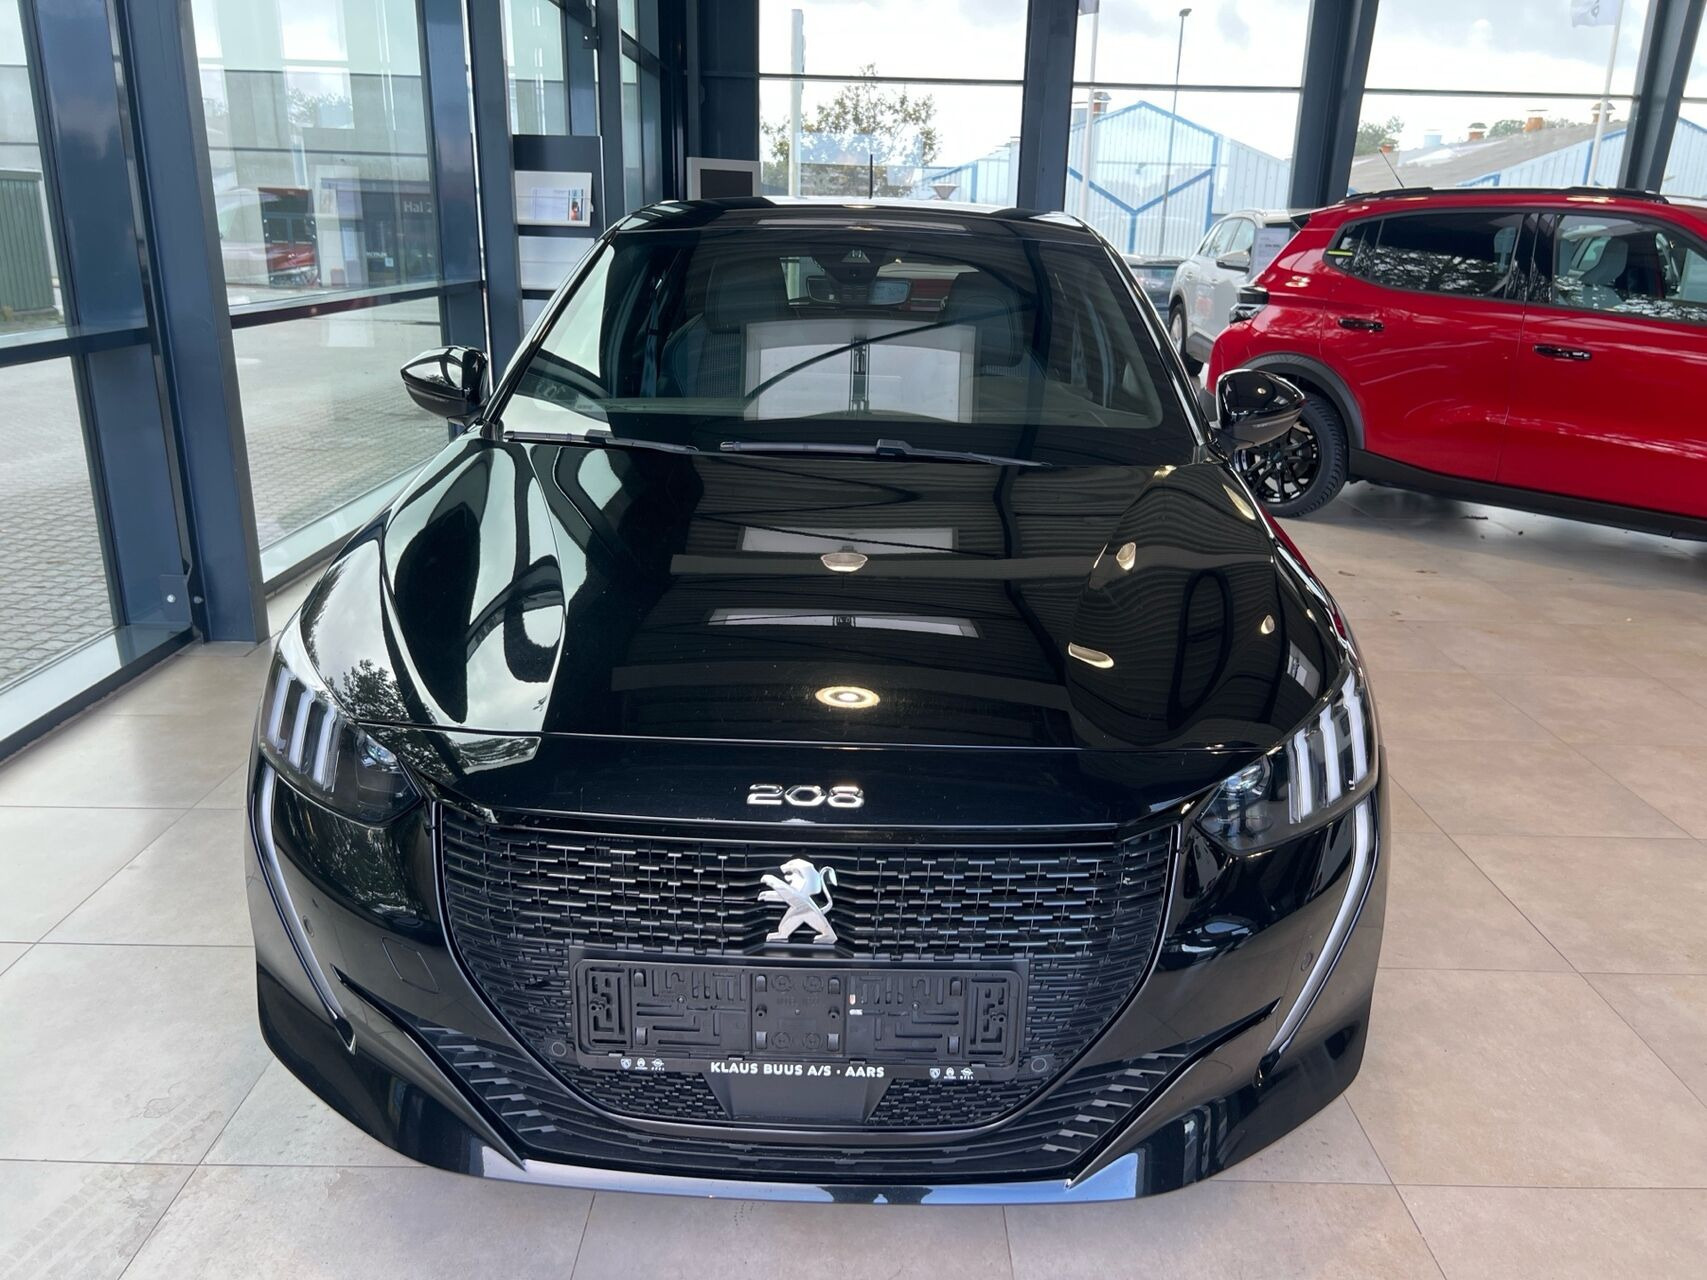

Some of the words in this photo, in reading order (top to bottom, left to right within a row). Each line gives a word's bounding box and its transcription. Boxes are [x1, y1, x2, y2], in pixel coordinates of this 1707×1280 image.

[403, 201, 423, 213] Hal
[746, 784, 864, 808] 208
[710, 1061, 758, 1074] KLAUS
[763, 1063, 803, 1075] BUUS
[807, 1065, 832, 1077] A/S
[845, 1066, 885, 1078] AARS
